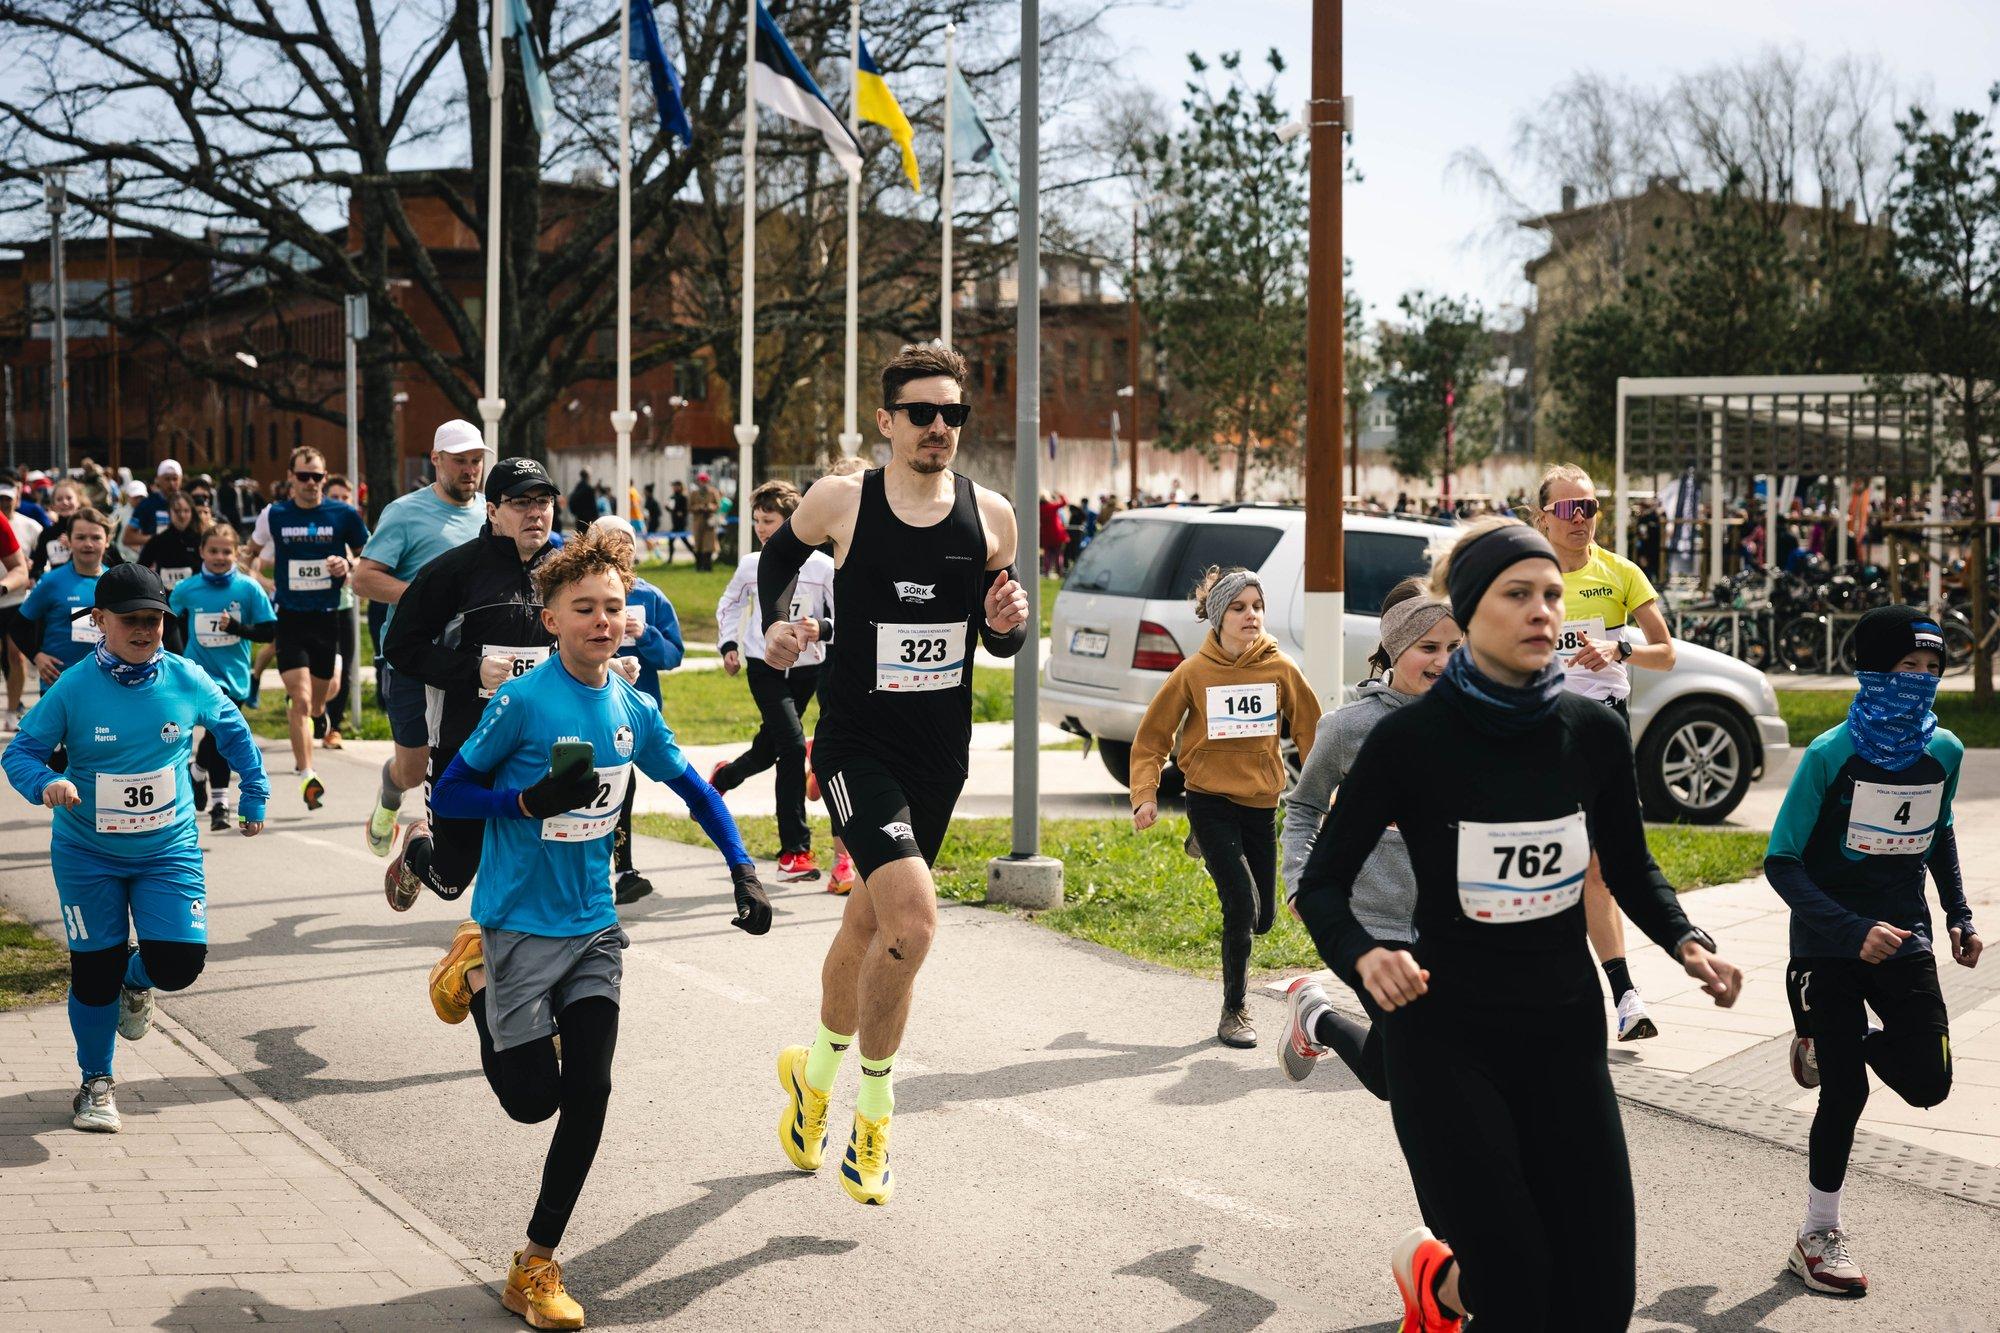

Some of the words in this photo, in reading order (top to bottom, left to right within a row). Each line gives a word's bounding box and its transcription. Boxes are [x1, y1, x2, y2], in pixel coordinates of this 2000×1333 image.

[298, 567, 321, 577] 628
[1580, 586, 1613, 598] sparta
[791, 603, 801, 617] 7
[210, 620, 222, 632] 7
[900, 638, 947, 663] 323
[512, 658, 535, 678] 65
[1225, 695, 1262, 715] 146
[94, 734, 117, 742] Marcus
[95, 726, 109, 734] Sten
[124, 785, 154, 808] 36
[1893, 801, 1911, 825] 4
[1493, 842, 1562, 880] 762
[64, 904, 89, 941] 31
